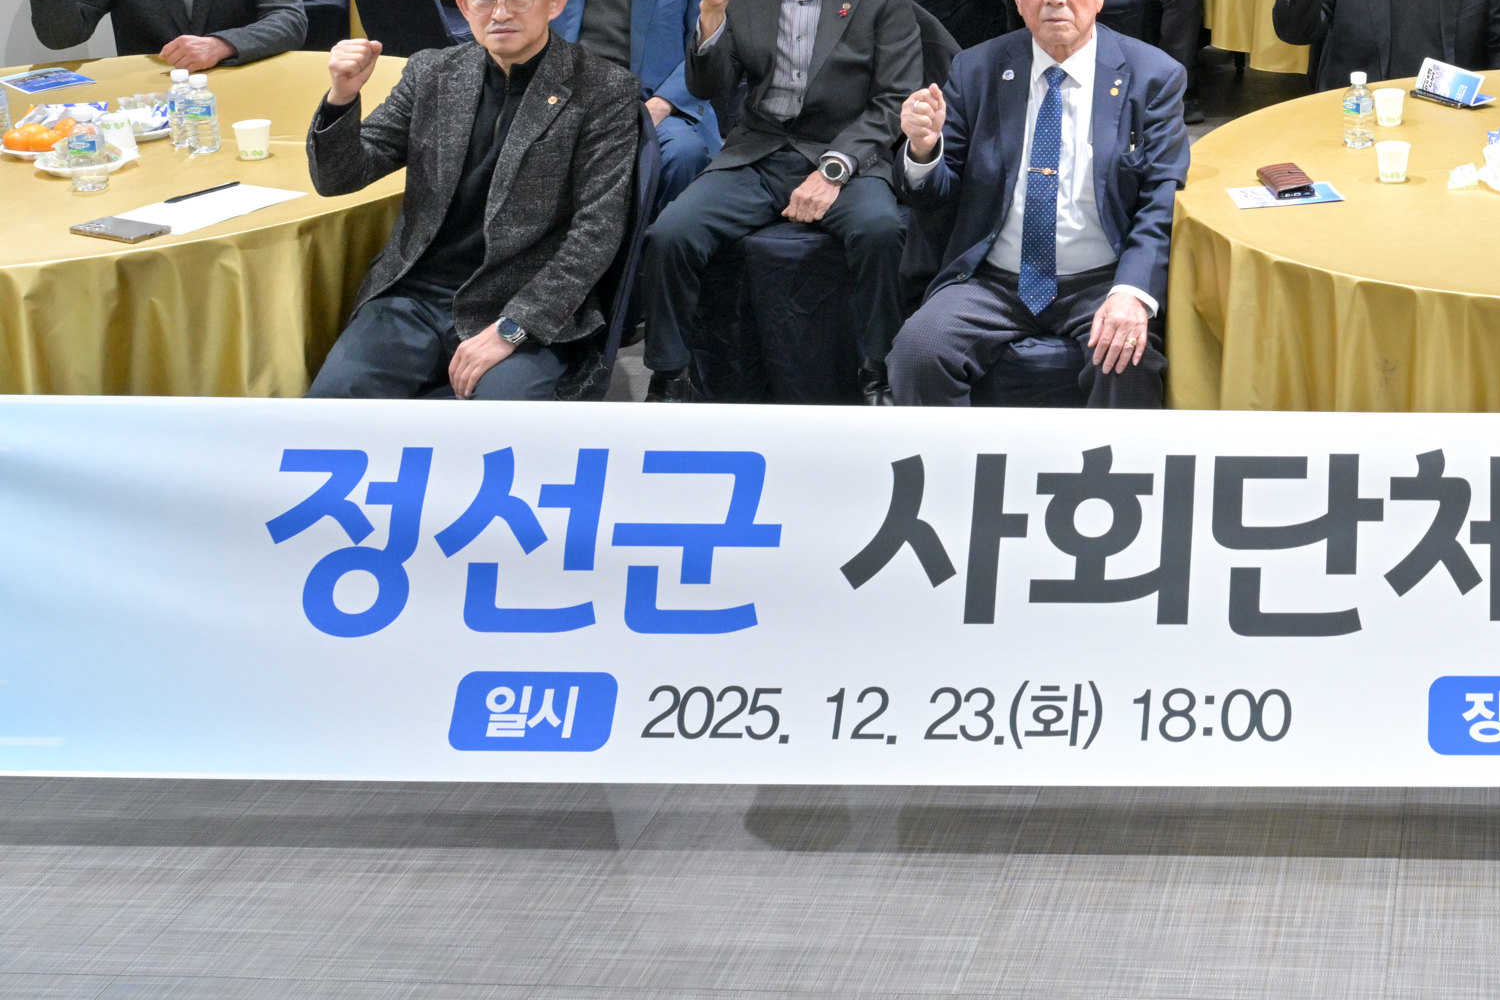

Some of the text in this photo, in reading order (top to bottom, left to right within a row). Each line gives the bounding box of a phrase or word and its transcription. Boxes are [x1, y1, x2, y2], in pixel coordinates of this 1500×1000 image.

[265, 447, 782, 638] 정선군
[486, 681, 1291, 749] 일시 2025. 12. 23.(화) 18:00
